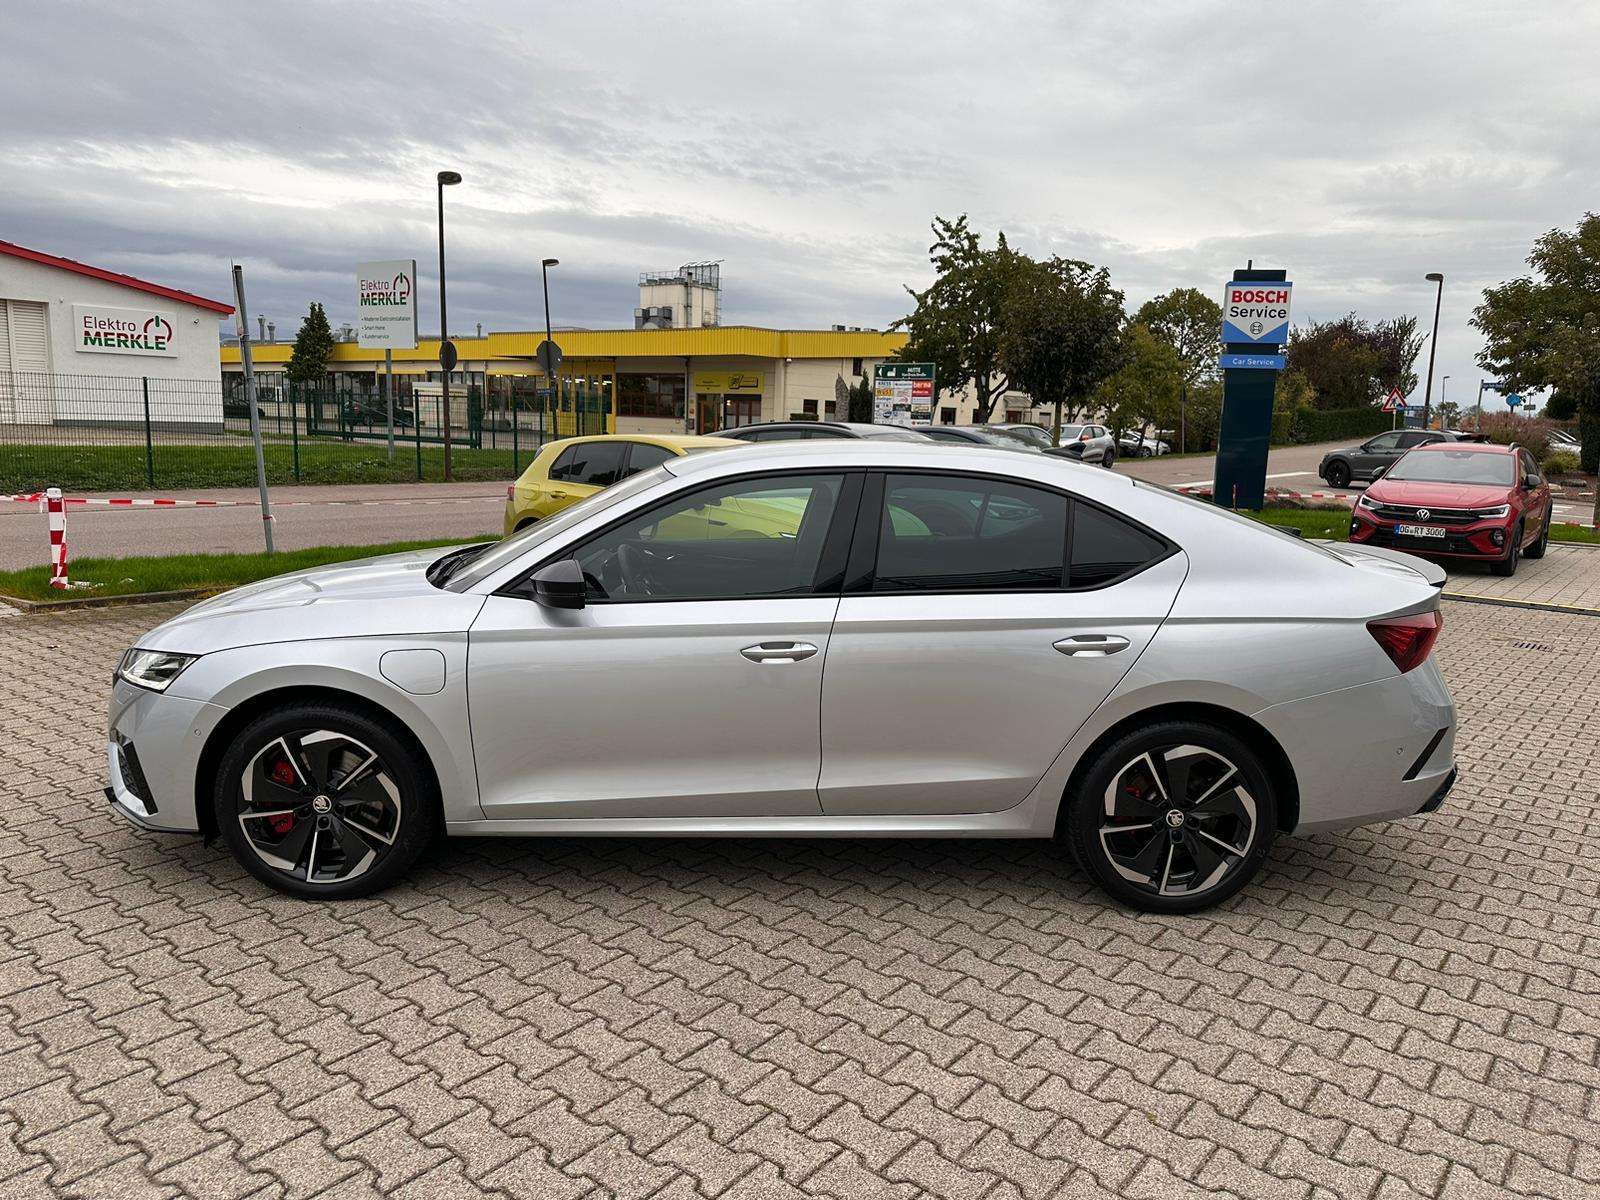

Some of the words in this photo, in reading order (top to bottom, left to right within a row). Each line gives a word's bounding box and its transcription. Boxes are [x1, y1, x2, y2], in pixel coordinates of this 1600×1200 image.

[360, 279, 390, 291] Elektro
[360, 291, 407, 306] MERKLE
[1231, 290, 1288, 303] BOSCH
[1229, 305, 1287, 318] Service
[83, 315, 136, 332] Elektro
[83, 330, 166, 350] MERKLE
[1232, 358, 1245, 366] Car
[1247, 358, 1275, 366] Service
[1399, 525, 1410, 534] OG
[1414, 526, 1424, 535] RT
[1425, 527, 1445, 537] 3000
